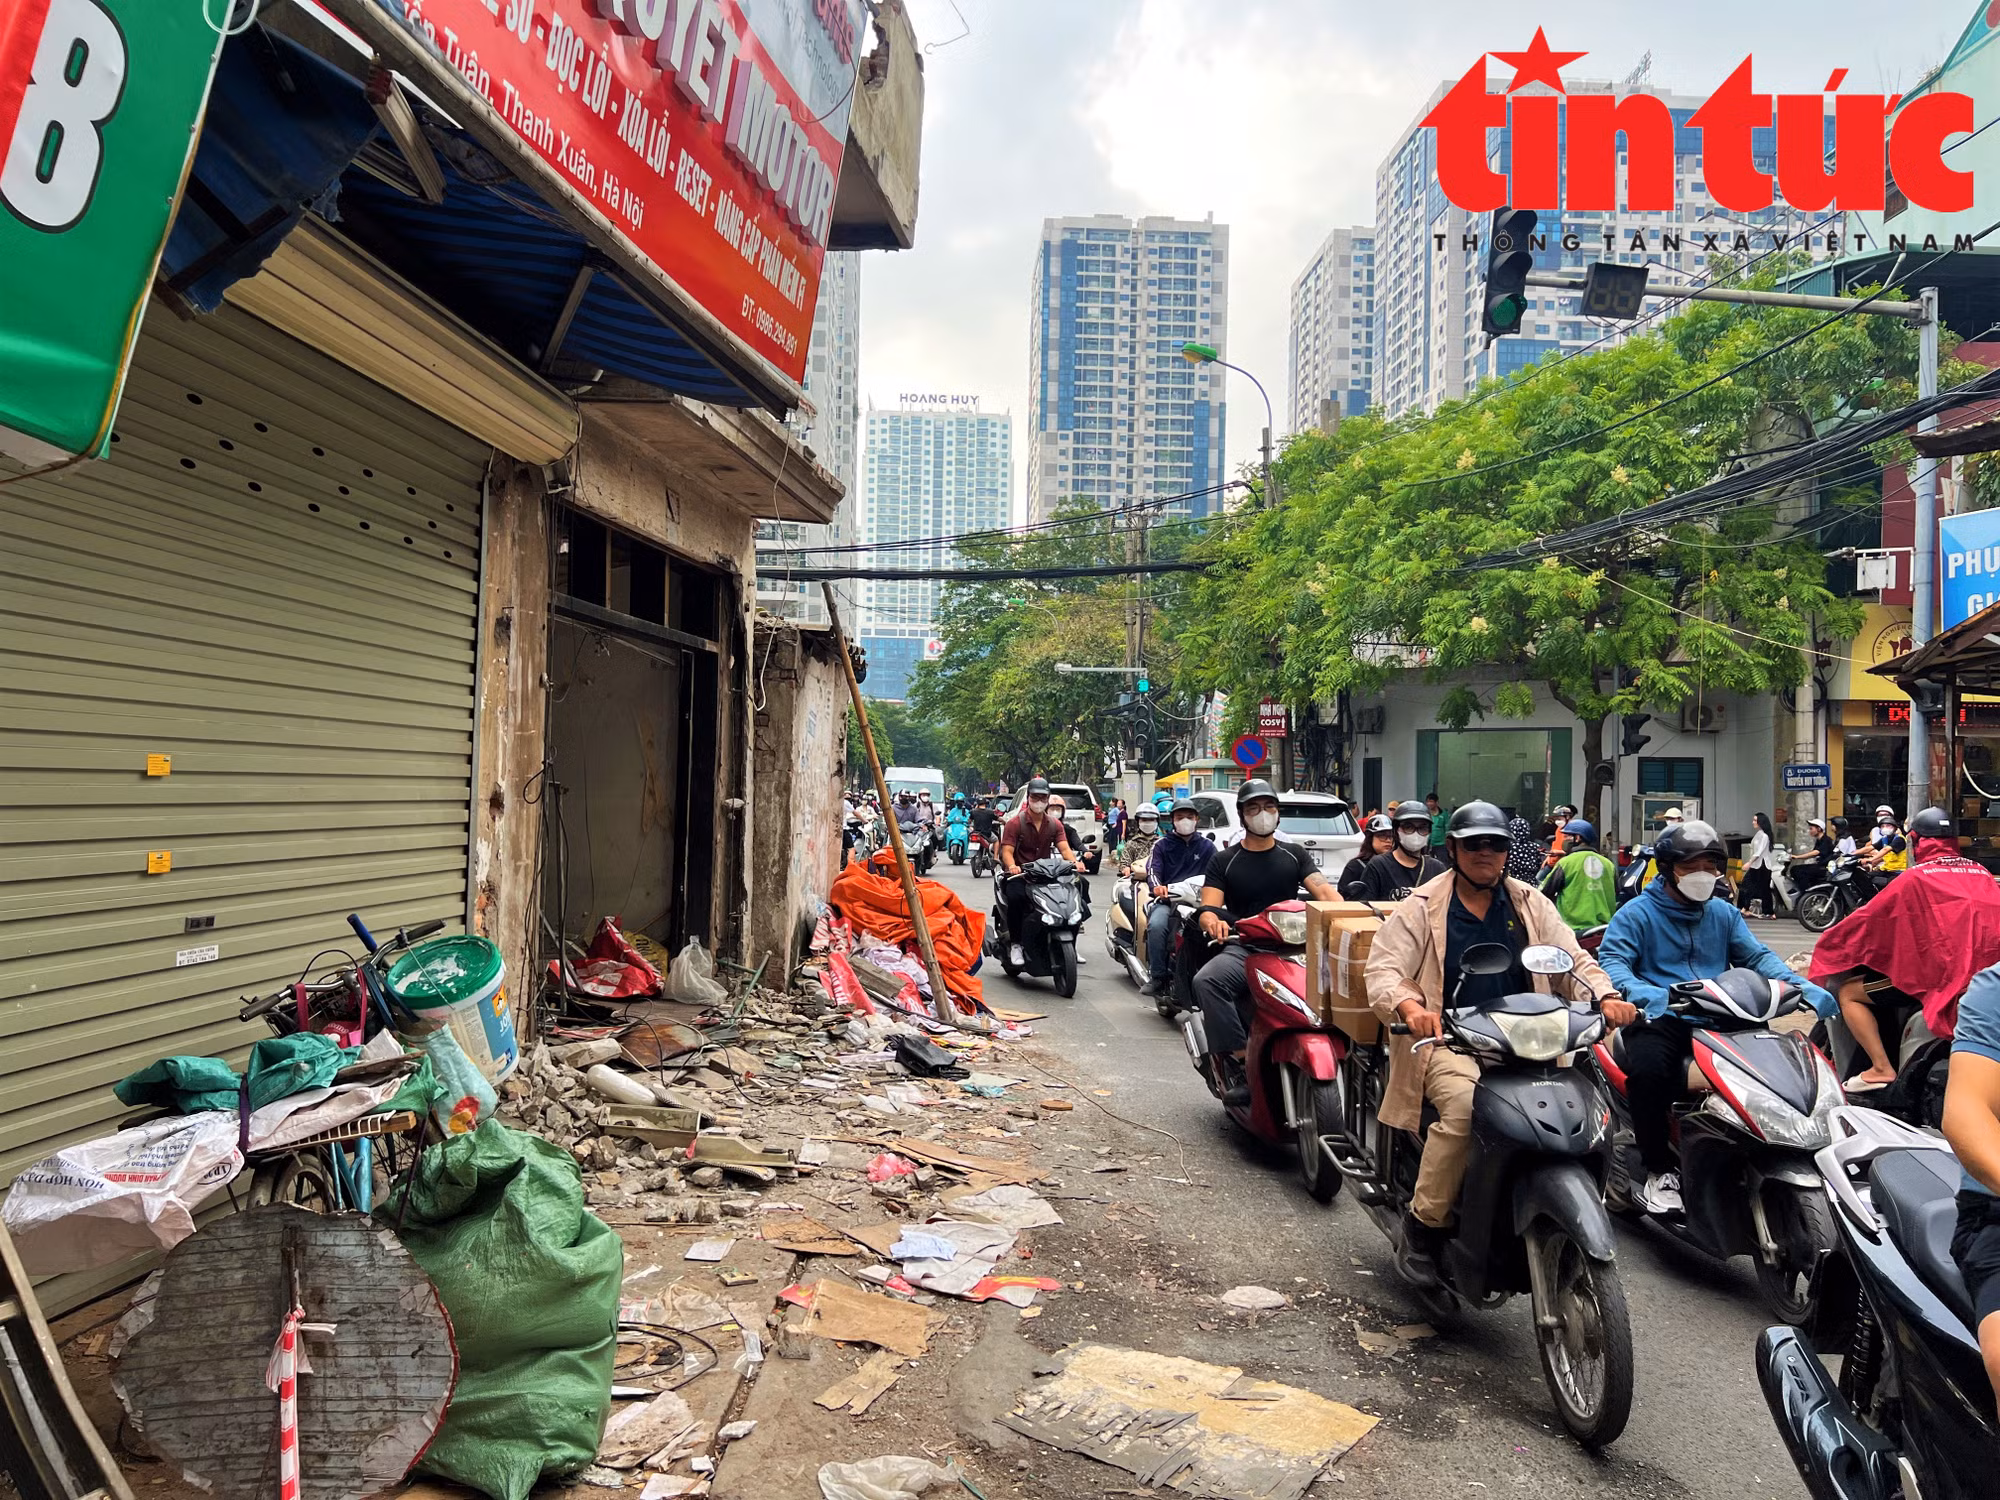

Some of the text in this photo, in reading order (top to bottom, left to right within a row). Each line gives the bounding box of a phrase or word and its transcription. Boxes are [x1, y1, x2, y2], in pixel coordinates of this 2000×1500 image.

[546, 11, 585, 94] ĐỌC
[582, 41, 613, 120] LỖI
[617, 87, 649, 158] XÓA
[646, 109, 672, 179] LỖI
[674, 147, 712, 218] RESET
[714, 190, 744, 251] NÂNG
[741, 213, 763, 267] CẤP
[503, 79, 554, 155] Thanh
[557, 130, 598, 198] Xuân,
[601, 169, 619, 211] Hà
[622, 187, 645, 231] Nội
[730, 60, 835, 241] MOTOR
[951, 394, 979, 405] HUY
[1967, 591, 2000, 617] GI
[1260, 718, 1281, 726] COSY
[1531, 1080, 1566, 1088] HONDA
[17, 1171, 45, 1185] DẠN
[46, 1173, 74, 1187] HỢP
